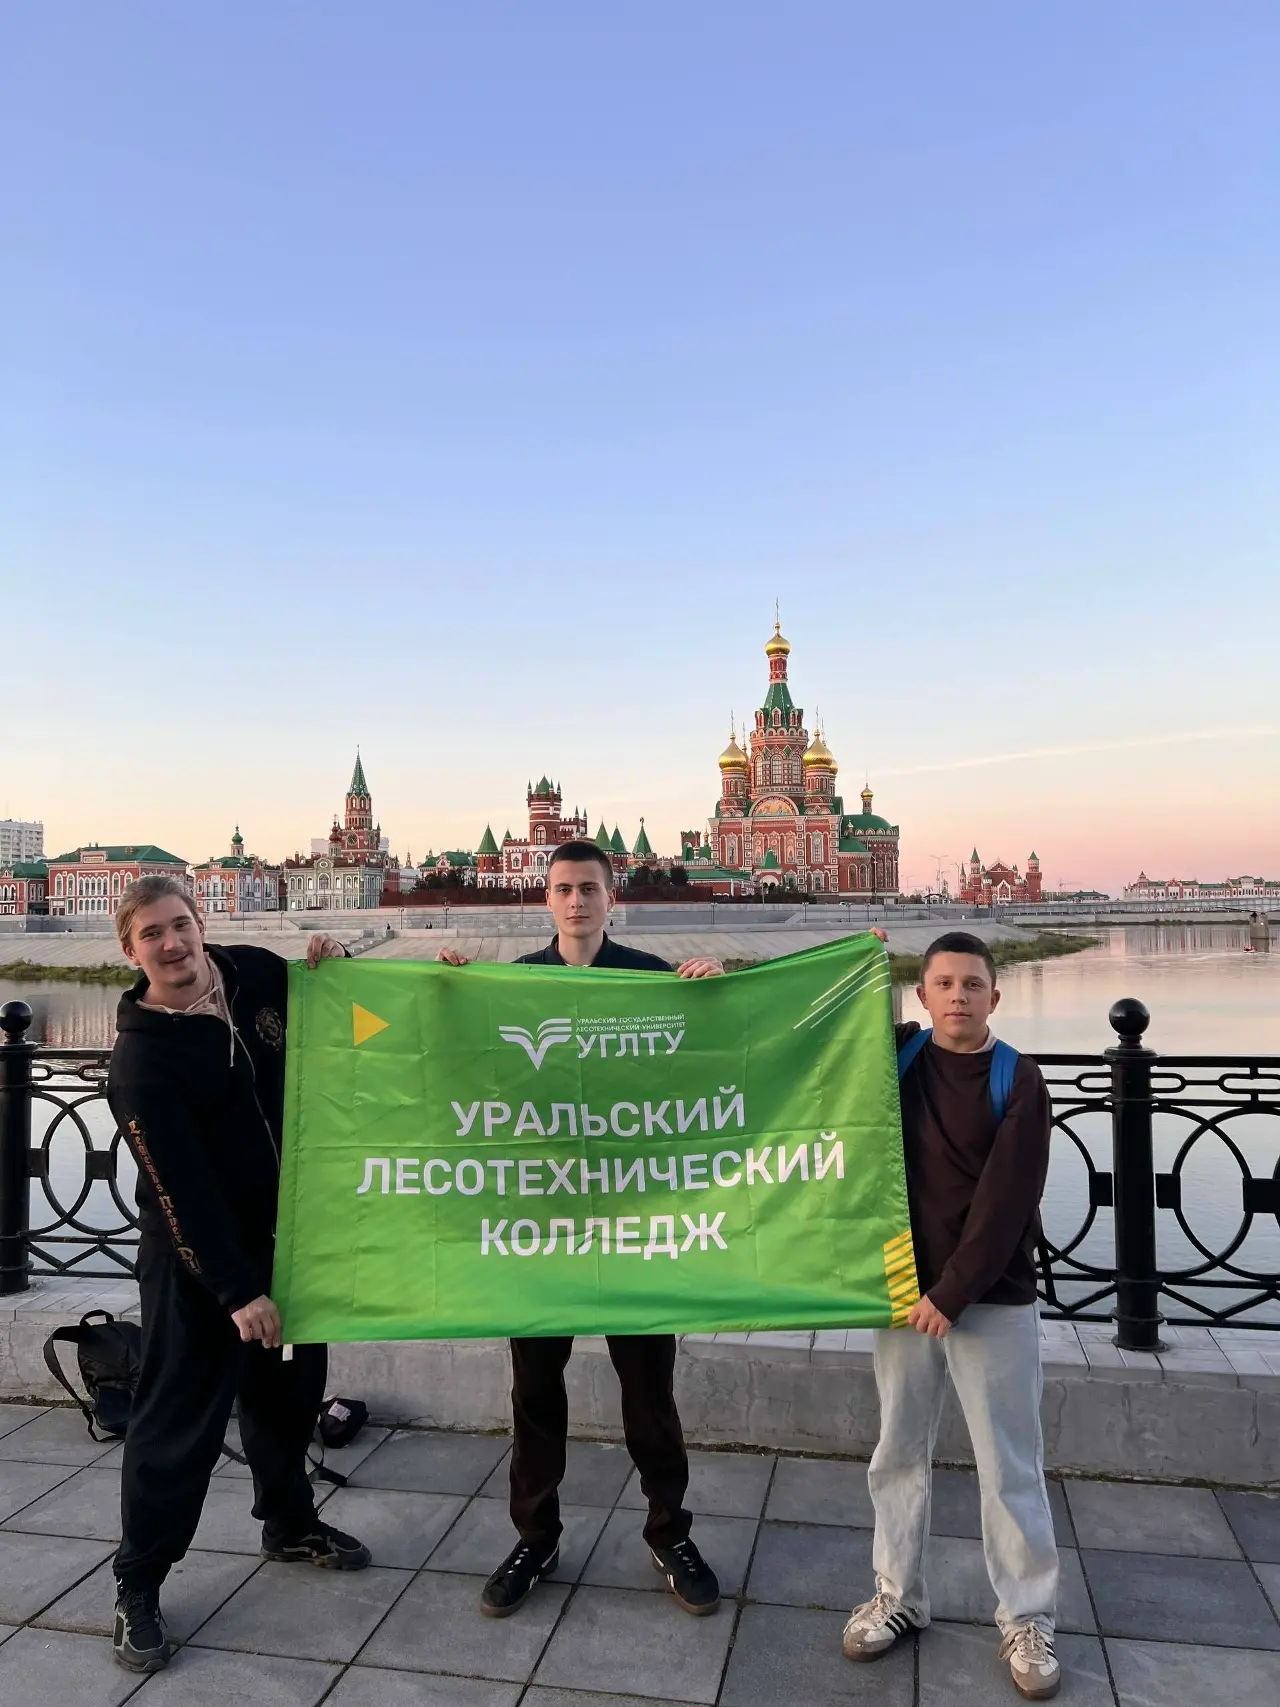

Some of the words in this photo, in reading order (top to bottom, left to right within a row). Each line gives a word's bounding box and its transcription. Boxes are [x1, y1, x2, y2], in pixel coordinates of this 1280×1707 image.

[576, 1024, 640, 1033] ЛЕСОТЕХНИЧЕСКИЙ
[642, 1021, 685, 1030] УНИВЕРСИТЕТ
[577, 1017, 617, 1025] УРАЛЬСКИЙ
[619, 1014, 685, 1023] ГОСУДАРСТВЕННЫЙ
[576, 1029, 685, 1059] УГЛТУ
[451, 1085, 745, 1137] УРАЛЬСКИЙ
[356, 1132, 845, 1195] ЛЕСОТЕХНИЧЕСКИЙ
[480, 1212, 727, 1259] КОЛЛЕДЖ
